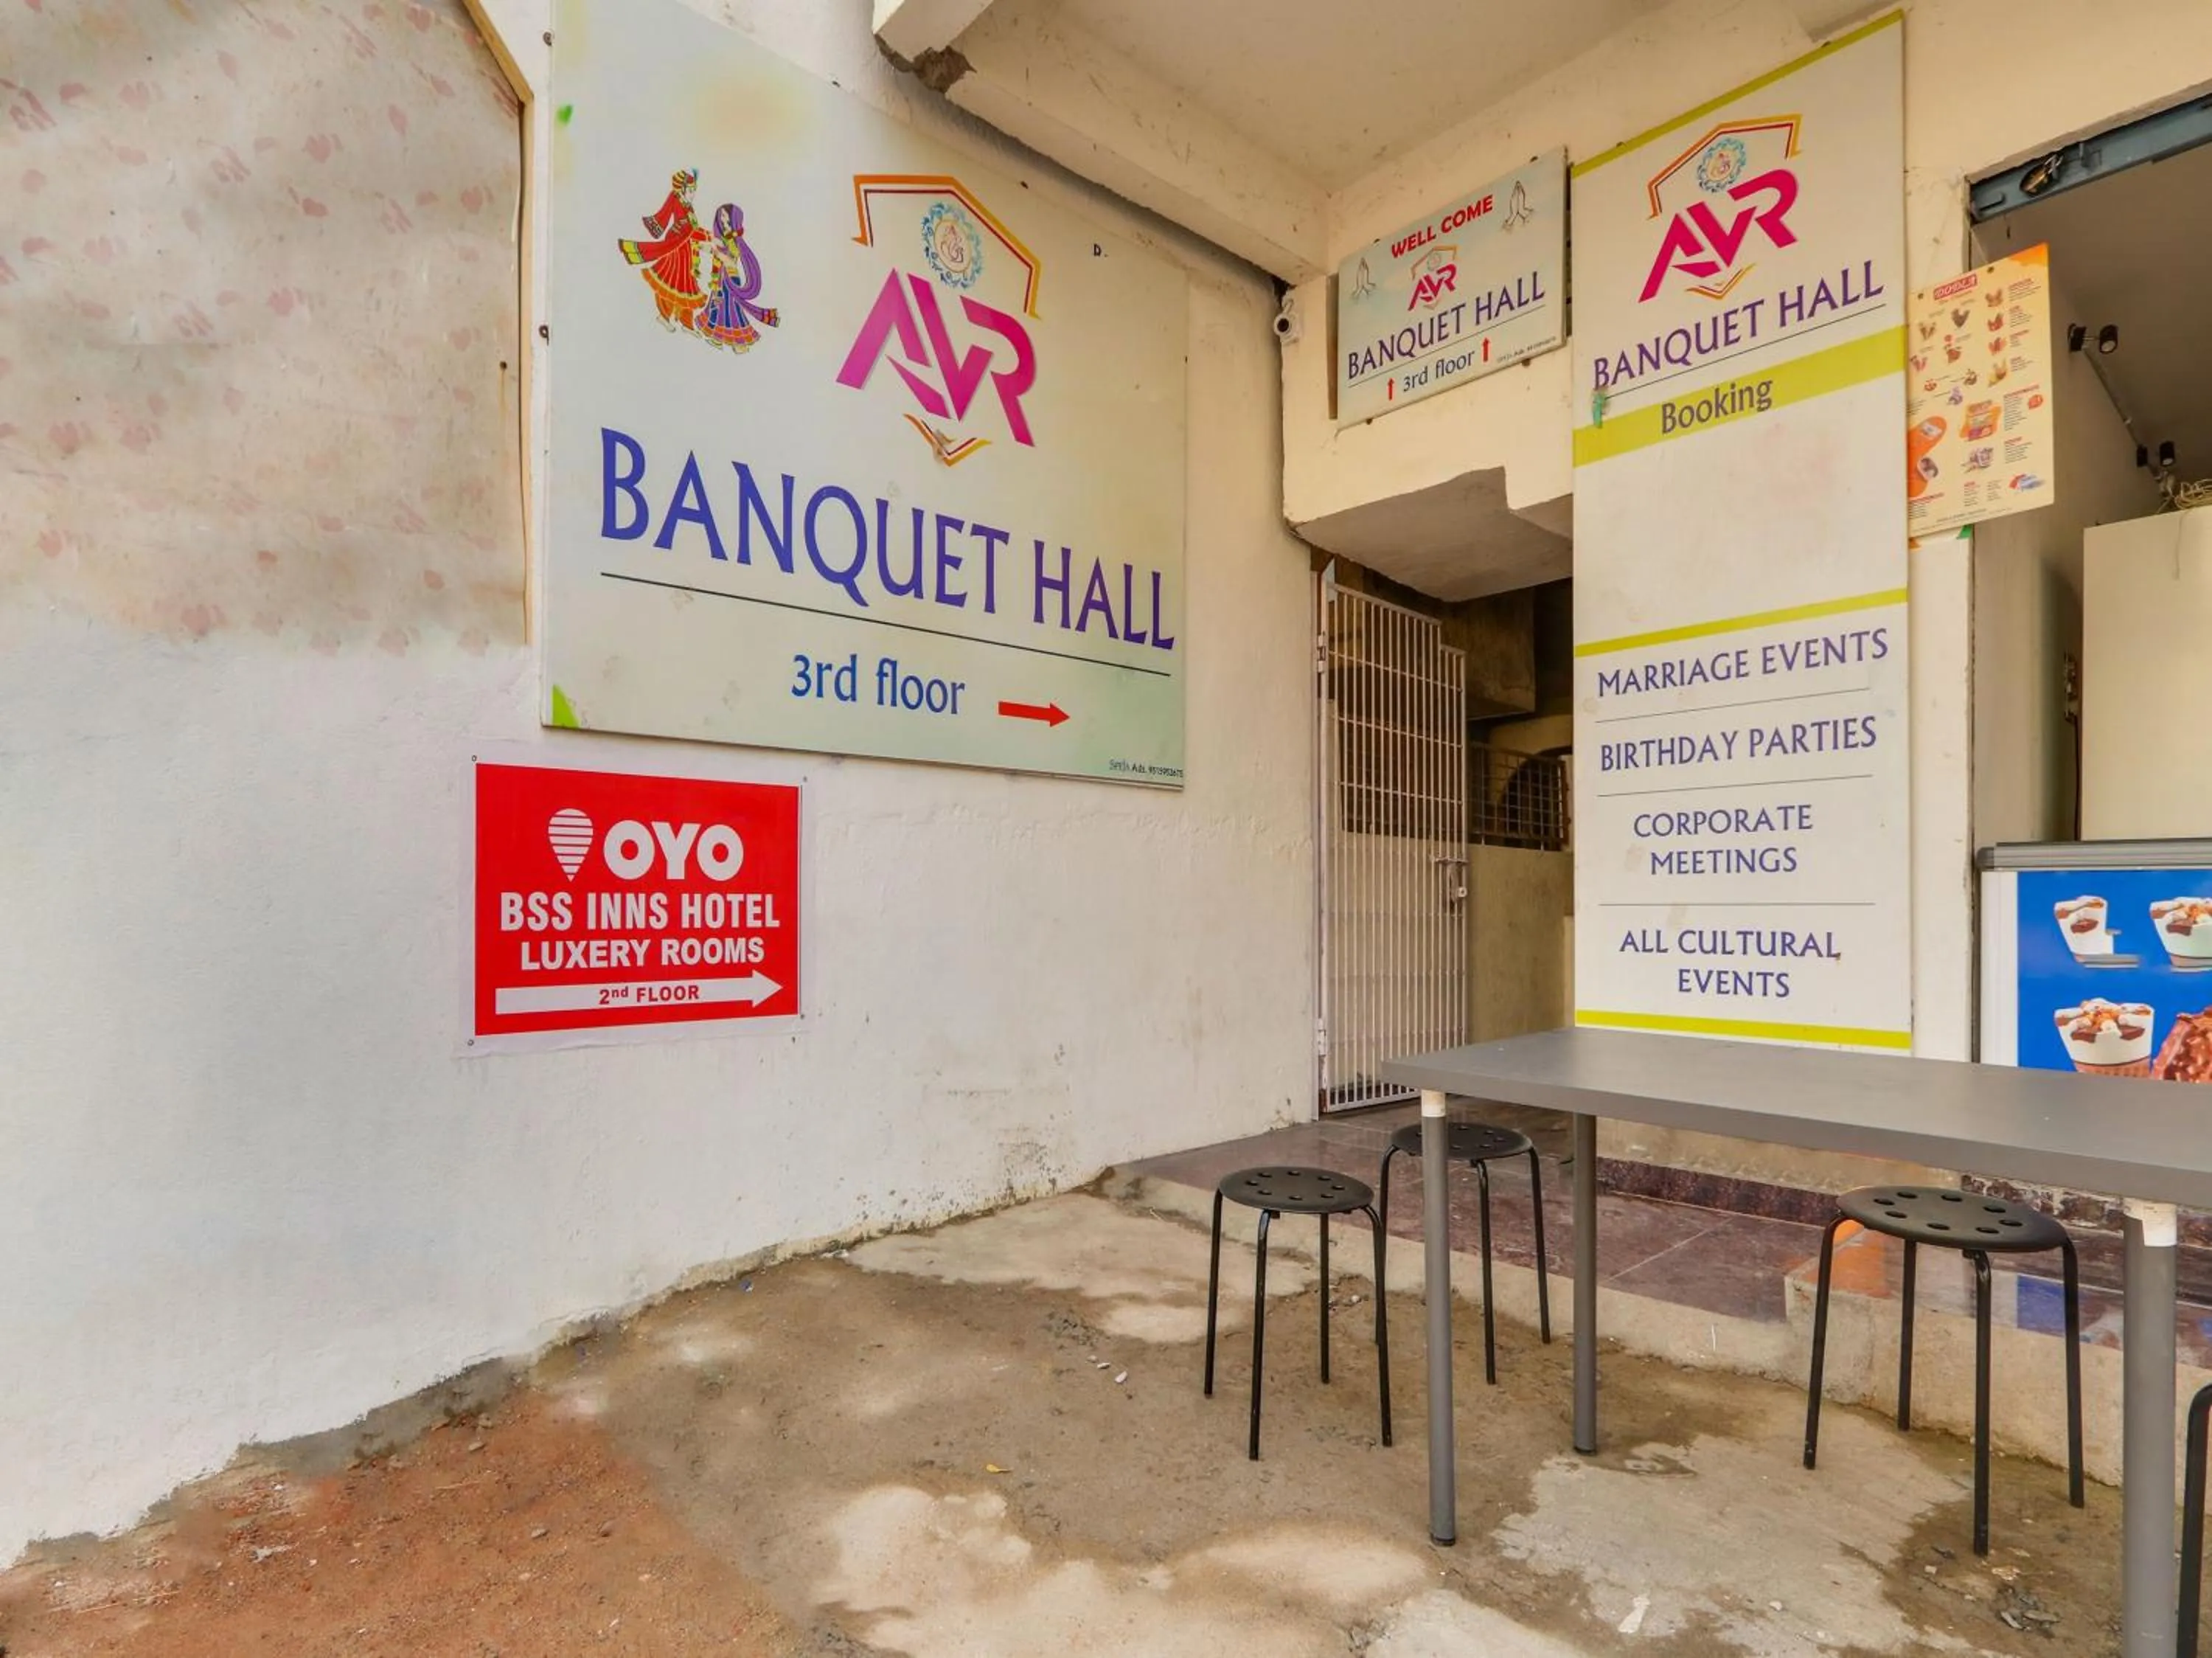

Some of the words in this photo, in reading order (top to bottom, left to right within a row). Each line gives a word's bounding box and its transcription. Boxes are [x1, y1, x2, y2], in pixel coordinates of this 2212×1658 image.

[1391, 226, 1436, 258] WELL
[1441, 195, 1493, 234] COME
[1638, 169, 1798, 304] AVR
[1349, 303, 1466, 380] BANQUET
[1475, 271, 1545, 326] HALL
[1593, 299, 1764, 390] BANQUET
[1778, 260, 1885, 327] HALL
[835, 268, 1036, 447] AVR
[1403, 366, 1428, 392] 3rd
[1436, 350, 1474, 379] floor
[1661, 380, 1773, 434] Booking
[601, 427, 1009, 614] BANQUET
[1033, 540, 1175, 651] HALL
[791, 653, 858, 701] 3rd
[876, 659, 965, 715] floor
[1598, 650, 1750, 697] MARRIAGE
[1761, 628, 1888, 676] EVENTS
[1601, 731, 1739, 771] BIRTHDAY
[1749, 716, 1877, 757] PARTIES
[1634, 805, 1813, 837] CORPORATE
[603, 819, 744, 881] OYO
[1651, 847, 1797, 875] MEETINGS
[500, 892, 573, 932] BSS
[587, 892, 668, 930] INNS
[681, 893, 780, 929] HOTEL
[521, 939, 651, 971] LUXERY
[661, 937, 765, 965] ROOMS
[1619, 930, 1669, 954] ALL
[1677, 930, 1840, 959] CULTURAL
[599, 987, 629, 1005] 2nd
[637, 985, 700, 1003] FLOOR
[1677, 969, 1790, 998] EVENTS
